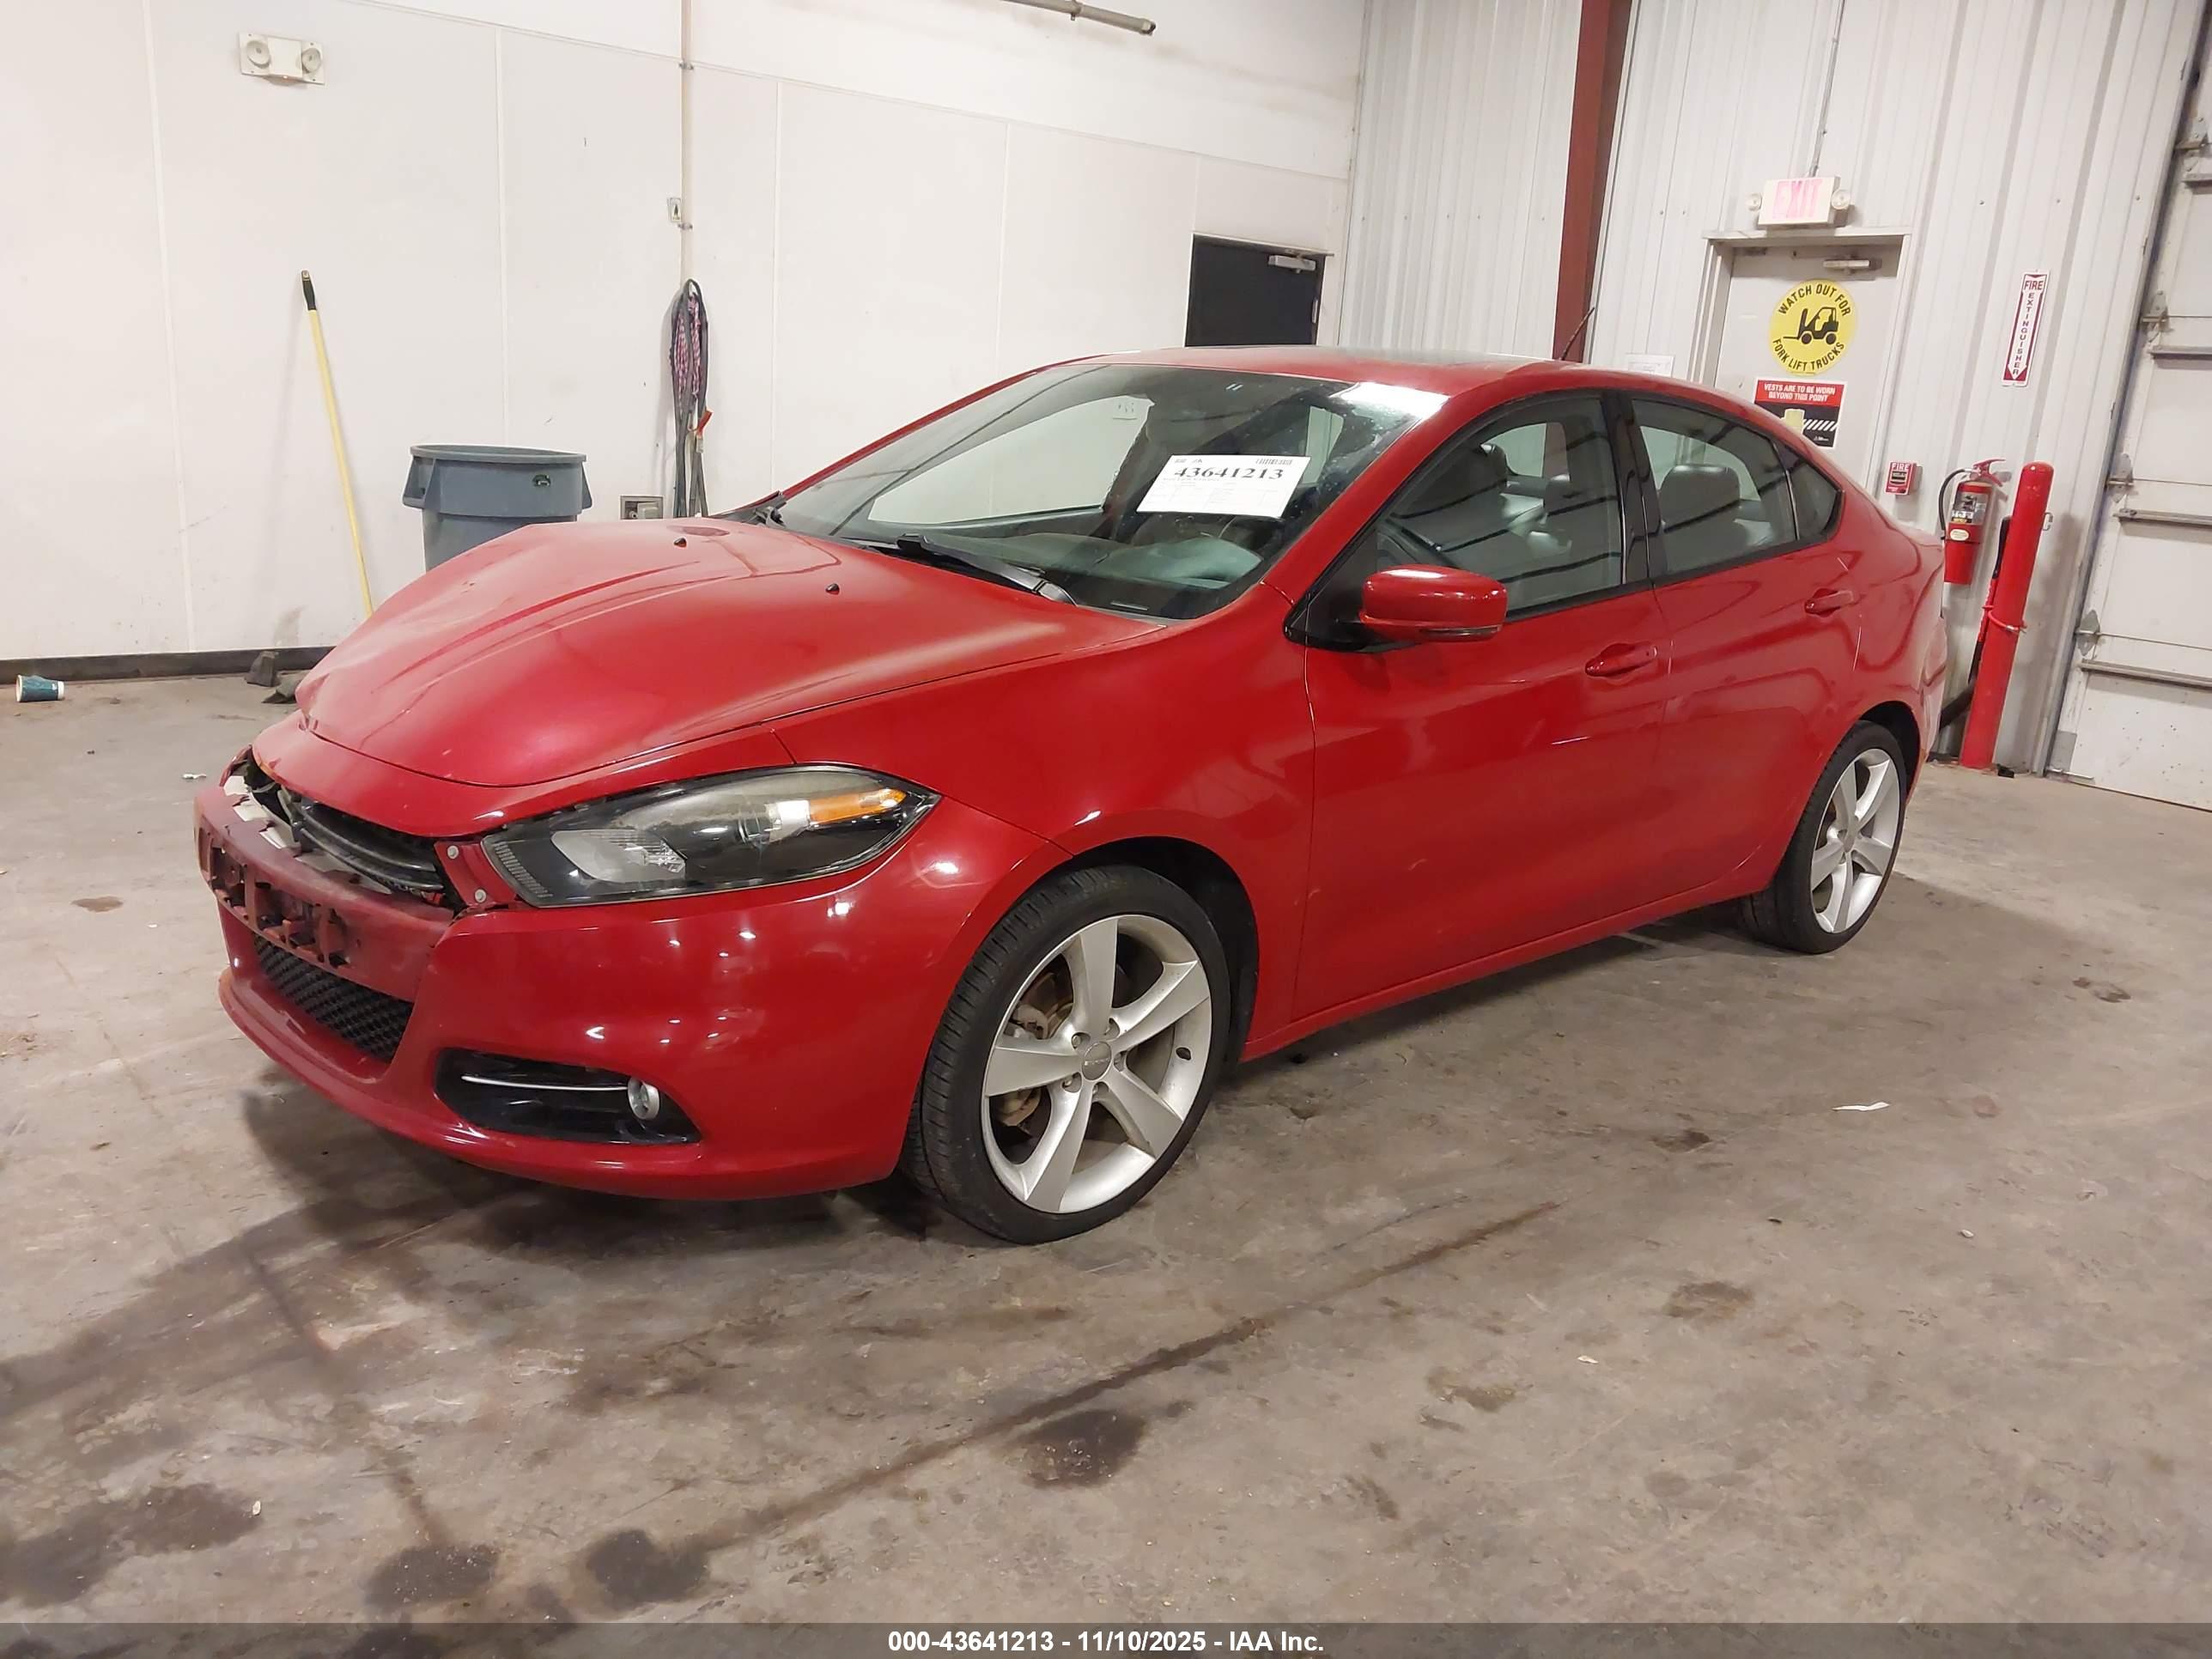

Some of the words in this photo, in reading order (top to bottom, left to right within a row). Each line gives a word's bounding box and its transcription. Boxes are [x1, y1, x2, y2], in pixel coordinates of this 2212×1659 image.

[1772, 179, 1822, 219] EXIT
[2024, 280, 2044, 290] FIRE
[1778, 284, 1812, 314] WATCH
[1816, 283, 1837, 297] OUT
[1834, 294, 1851, 316] FOR
[2012, 292, 2035, 375] EXTINGUISHER
[1772, 338, 1790, 363] FORK
[1788, 358, 1808, 372] LIFT
[1811, 342, 1844, 371] TRUCKS
[1764, 383, 1784, 392] VESTS
[1815, 386, 1836, 395] WORN
[1794, 392, 1808, 401] THIS
[1809, 393, 1829, 402] POINT
[1174, 467, 1284, 480] 43641213
[1892, 463, 1911, 471] FIRE
